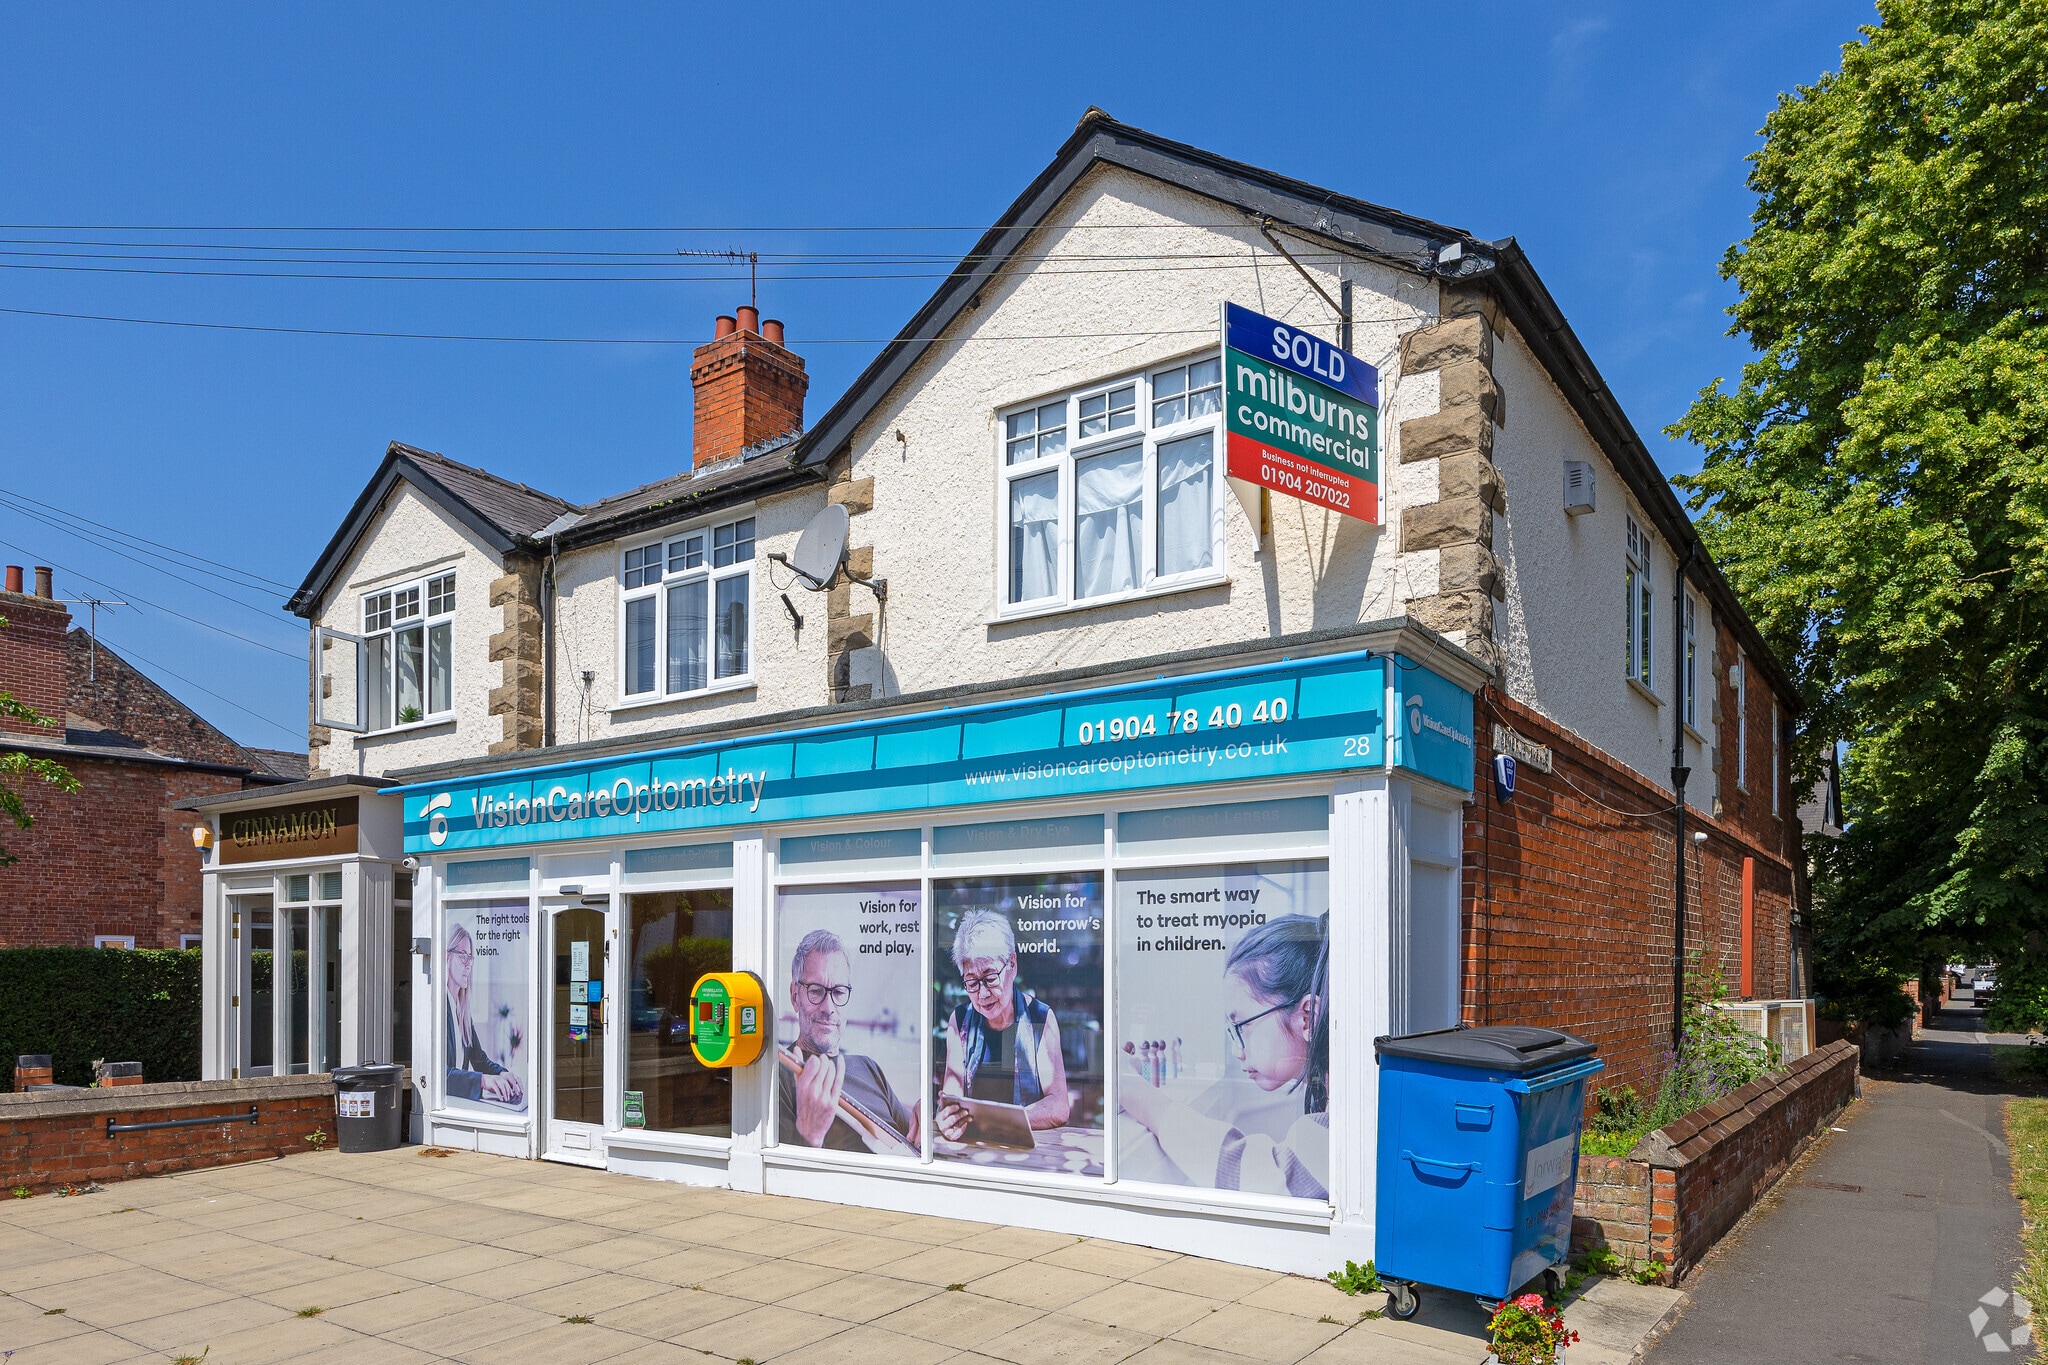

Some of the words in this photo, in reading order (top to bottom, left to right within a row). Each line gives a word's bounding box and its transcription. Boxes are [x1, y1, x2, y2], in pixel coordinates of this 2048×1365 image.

[1272, 327, 1345, 382] SOLD
[1237, 364, 1369, 441] milburns
[1238, 405, 1369, 470] commercial
[1262, 449, 1294, 468] Business
[1296, 463, 1309, 473] not
[1310, 466, 1350, 488] interrupted
[1261, 464, 1302, 491] 01904
[1305, 479, 1350, 508] 207022
[1079, 714, 1157, 746] 01904
[1166, 708, 1199, 735] 78
[1208, 703, 1243, 730] 40
[1252, 697, 1288, 724] 40
[1422, 713, 1472, 749] VisionCareOptometry
[1343, 736, 1371, 757] 28
[964, 734, 1288, 786] www.visioncareoptometry.co.uk
[471, 767, 767, 828] VisionCareOptometry
[232, 807, 337, 843] CINNAMON
[1161, 811, 1219, 828] Contact
[1224, 808, 1281, 824] Lenses
[966, 829, 1004, 841] Vision
[1007, 826, 1016, 839] &
[1020, 825, 1042, 841] Dry
[1046, 823, 1071, 840] Eye
[810, 840, 841, 852] Vision
[844, 839, 853, 850] &
[855, 837, 892, 849] Colour
[642, 852, 669, 863] Vision
[671, 850, 686, 860] and
[688, 848, 720, 860] Driving
[457, 866, 479, 875] Vision
[493, 862, 524, 873] Learning
[1017, 894, 1060, 909] Vision
[1064, 893, 1087, 908] for
[1136, 889, 1166, 905] The
[1170, 888, 1221, 904] smart
[1224, 889, 1260, 904] way
[859, 899, 896, 913] Vision
[898, 898, 918, 912] for
[476, 914, 490, 925] The
[491, 913, 509, 926] right
[511, 912, 529, 924] tools
[859, 920, 893, 935] work,
[894, 921, 920, 933] rest
[1017, 916, 1101, 931] tomorrow's
[1136, 914, 1153, 928] to
[1157, 913, 1199, 928] treat
[1203, 909, 1266, 930] myopia
[476, 930, 487, 940] for
[488, 930, 500, 940] the
[502, 929, 521, 942] right
[1137, 936, 1151, 951] in
[1155, 935, 1226, 951] children.
[476, 946, 499, 956] vision.
[859, 940, 883, 954] and
[885, 940, 915, 957] play.
[1017, 938, 1060, 953] world.
